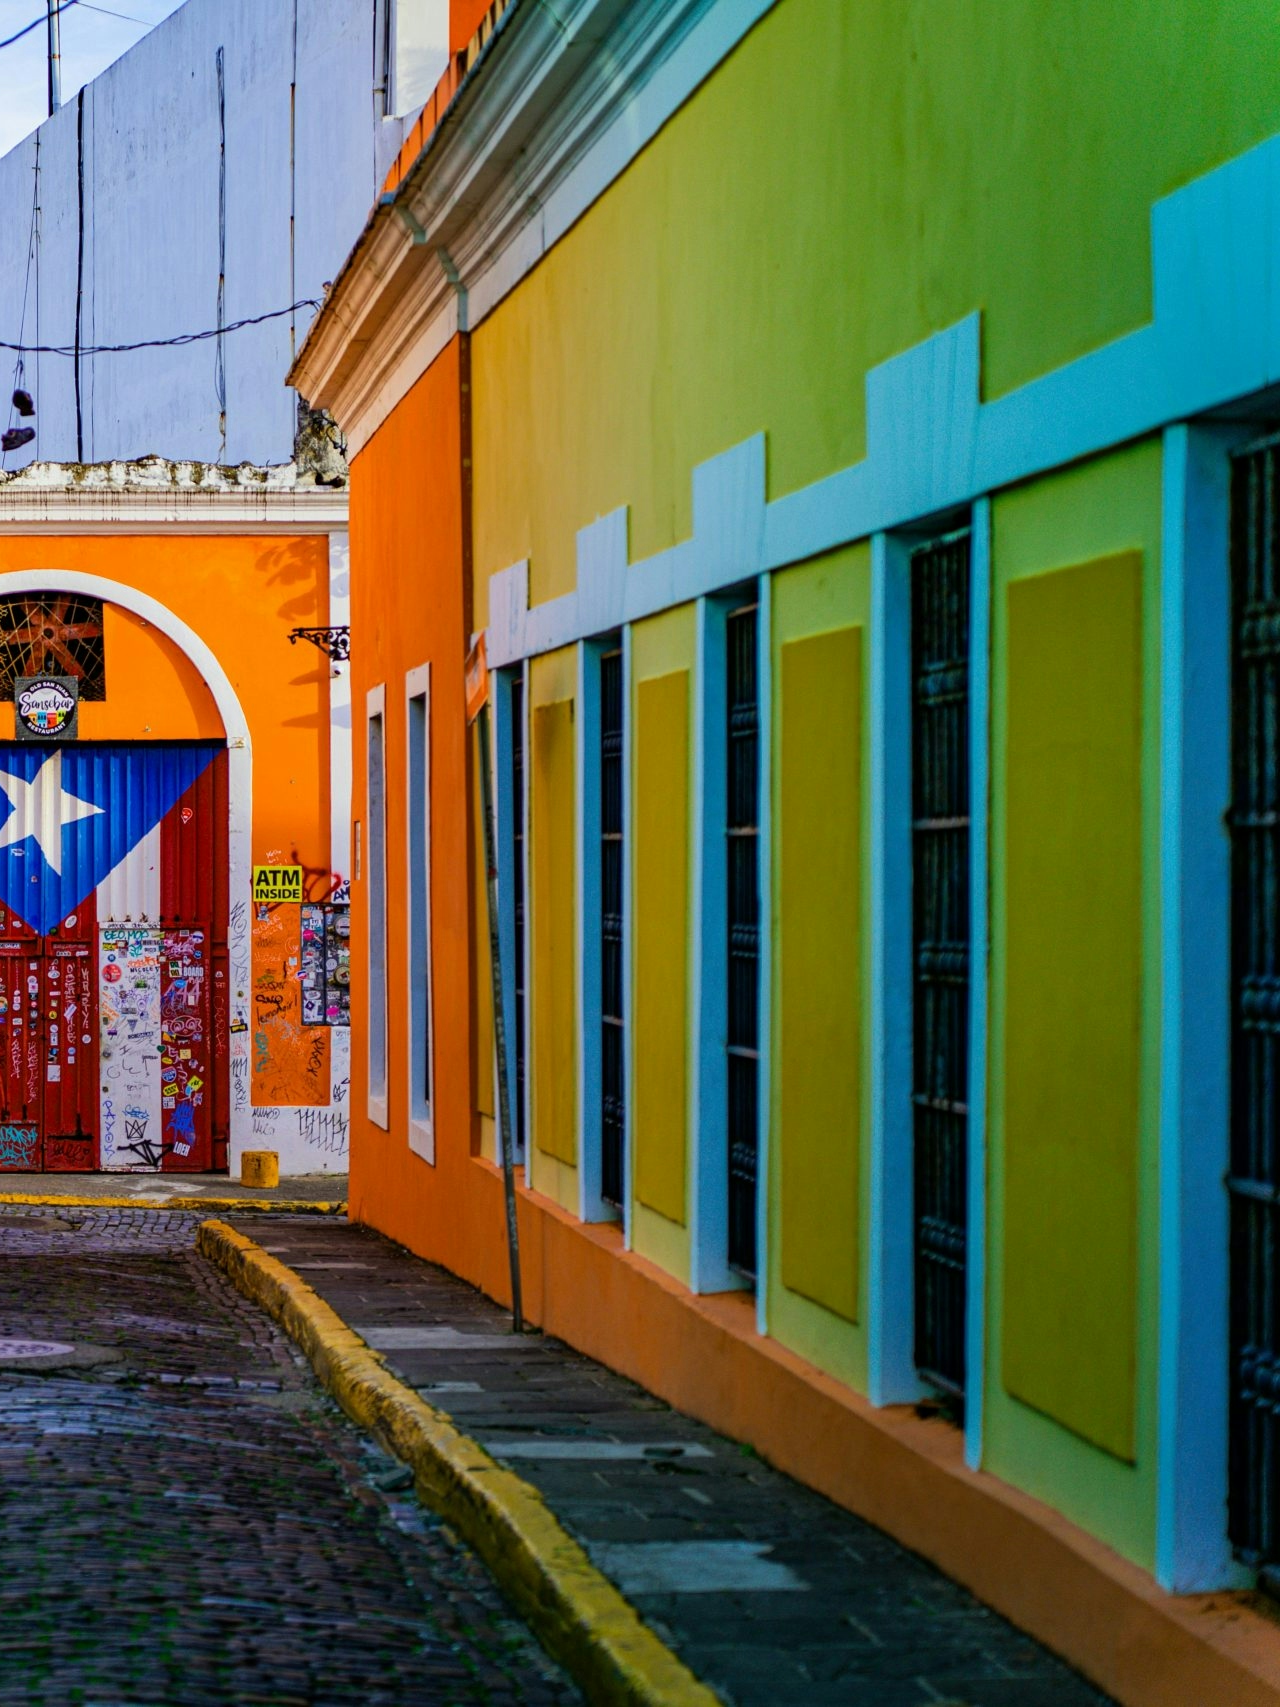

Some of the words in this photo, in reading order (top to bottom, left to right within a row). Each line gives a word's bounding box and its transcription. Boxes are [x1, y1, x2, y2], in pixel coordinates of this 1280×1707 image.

[30, 683, 41, 691] OLD
[55, 684, 69, 697] JUAN
[21, 694, 72, 715] Sansebar
[27, 722, 66, 734] RESTAURANT
[255, 870, 300, 886] ATM
[255, 889, 300, 899] INSIDE
